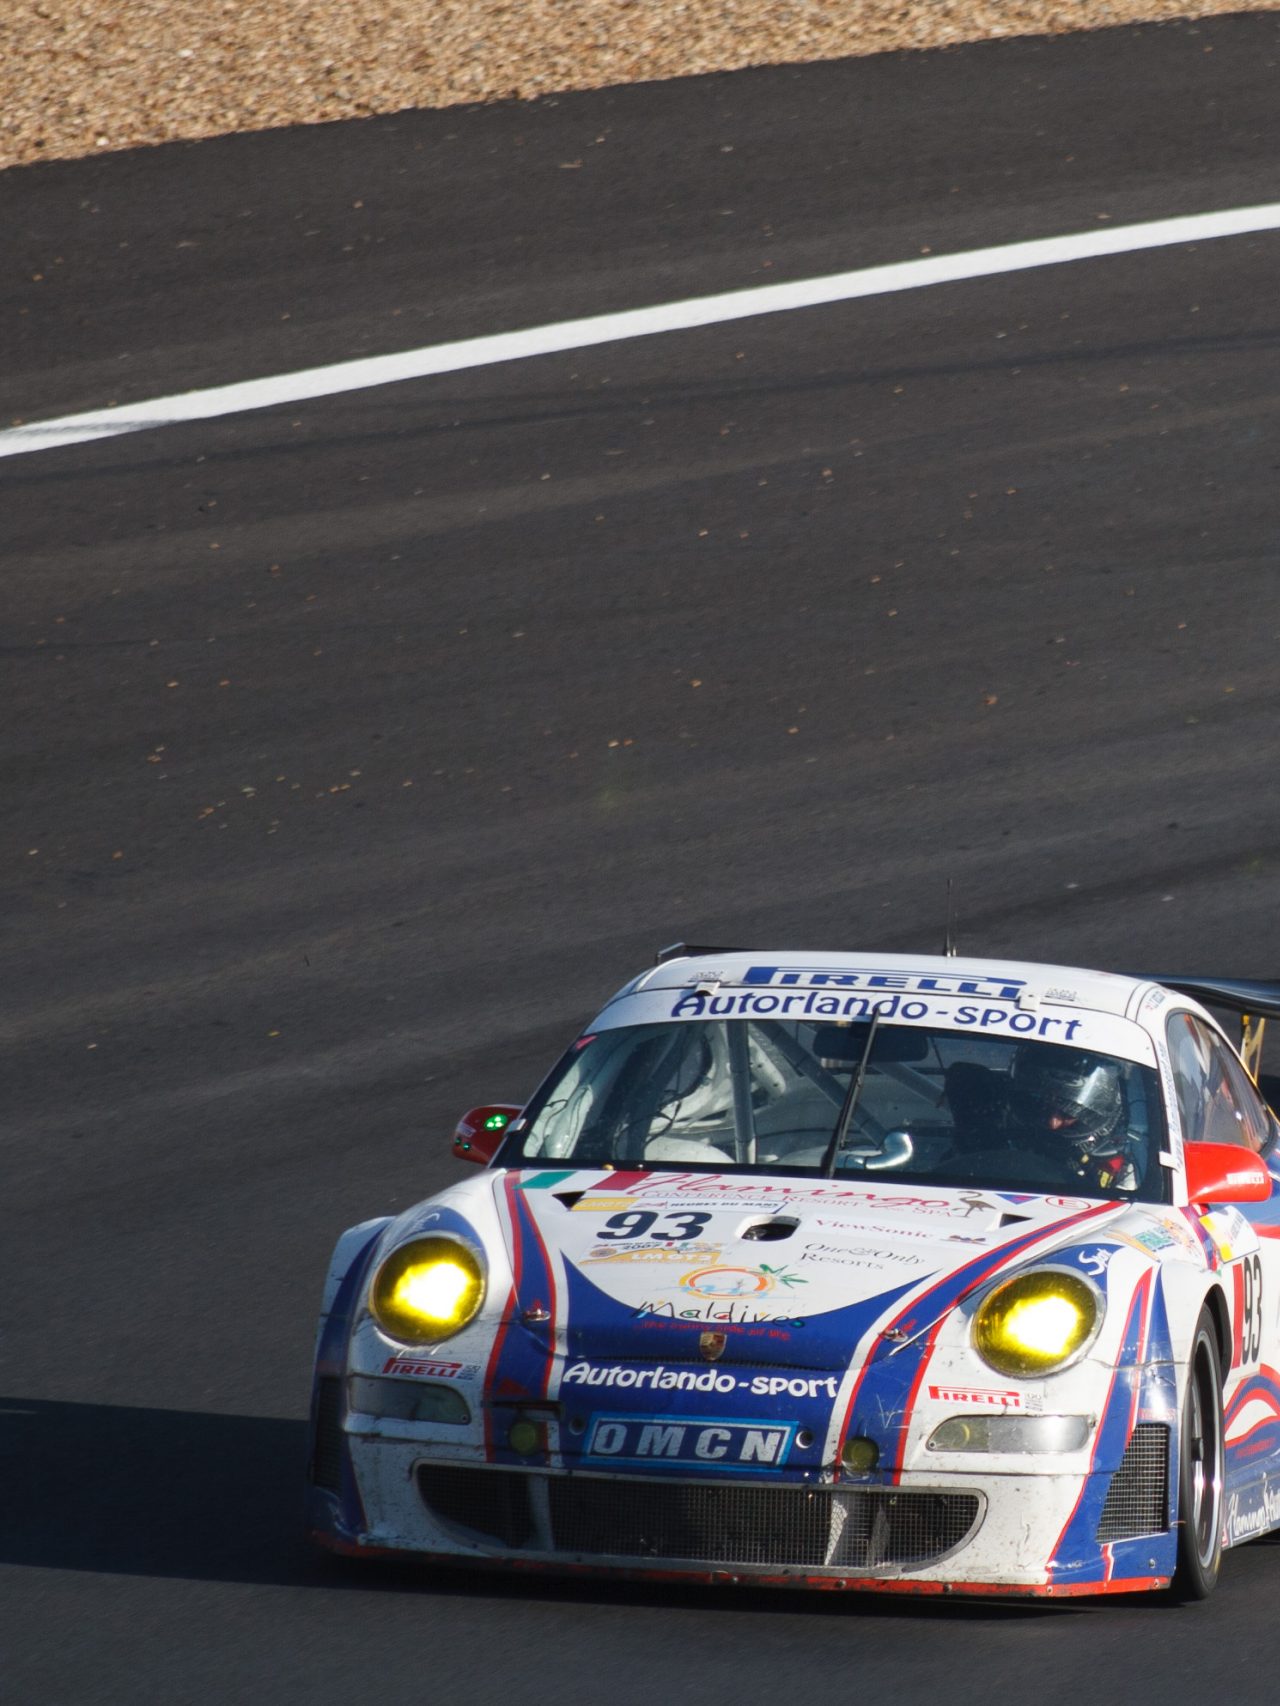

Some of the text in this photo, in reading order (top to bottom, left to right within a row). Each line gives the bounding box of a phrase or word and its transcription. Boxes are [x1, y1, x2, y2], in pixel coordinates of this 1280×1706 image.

[742, 966, 1027, 1000] PIRELLI
[671, 991, 1083, 1041] Autorlando-sport
[626, 1173, 950, 1208] Flamingo
[596, 1211, 713, 1241] 93
[815, 1218, 934, 1239] ViewSonic
[800, 1252, 884, 1270] Resorts
[630, 1300, 811, 1328] Maldives
[1242, 1254, 1262, 1365] 93
[382, 1357, 463, 1378] PIRELLI
[563, 1361, 838, 1399] Autorlando-sport
[928, 1385, 1020, 1407] PIRELLI
[593, 1423, 782, 1464] OMCN
